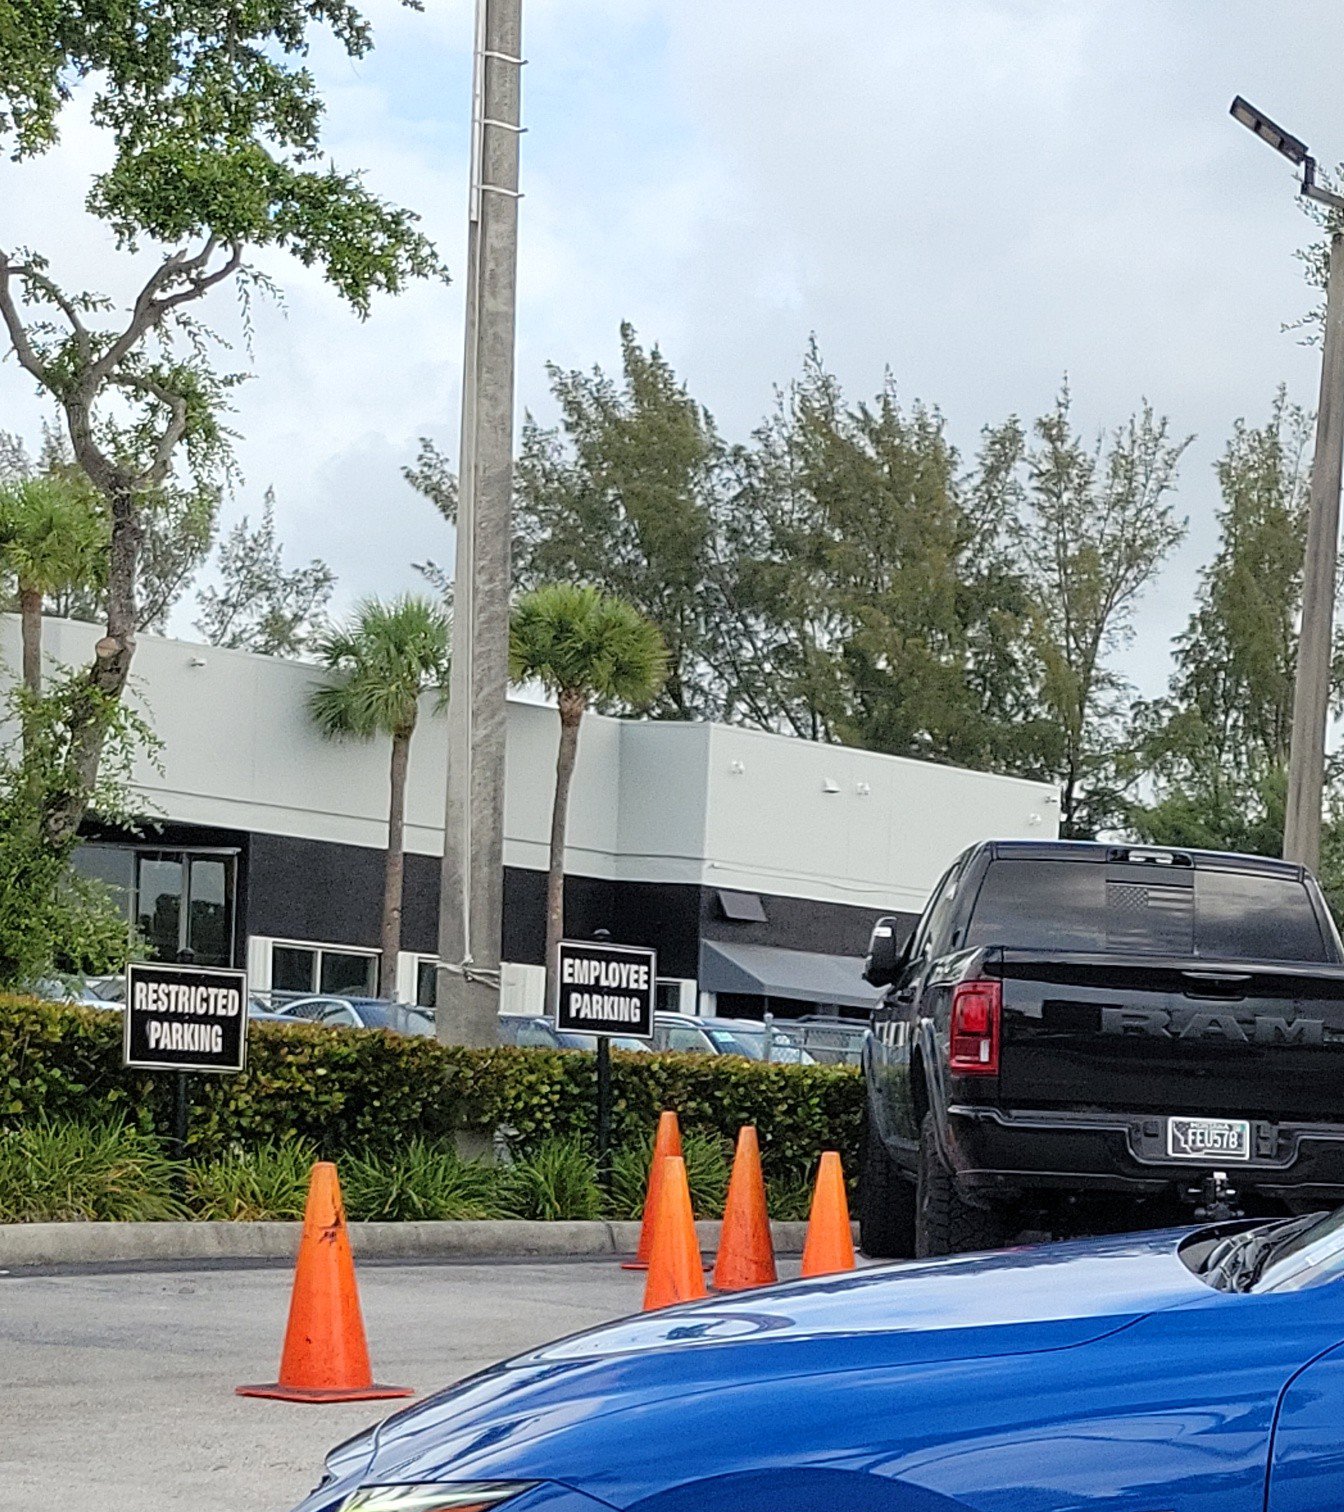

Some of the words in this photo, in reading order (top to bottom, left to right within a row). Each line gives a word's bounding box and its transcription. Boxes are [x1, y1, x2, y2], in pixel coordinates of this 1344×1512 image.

[562, 957, 648, 990] EMPLOYEE
[134, 981, 239, 1017] RESTRICTED
[570, 992, 640, 1023] PARKING
[148, 1020, 222, 1053] PARKING
[1101, 1008, 1324, 1045] RAM
[1188, 1128, 1238, 1149] FEU578
